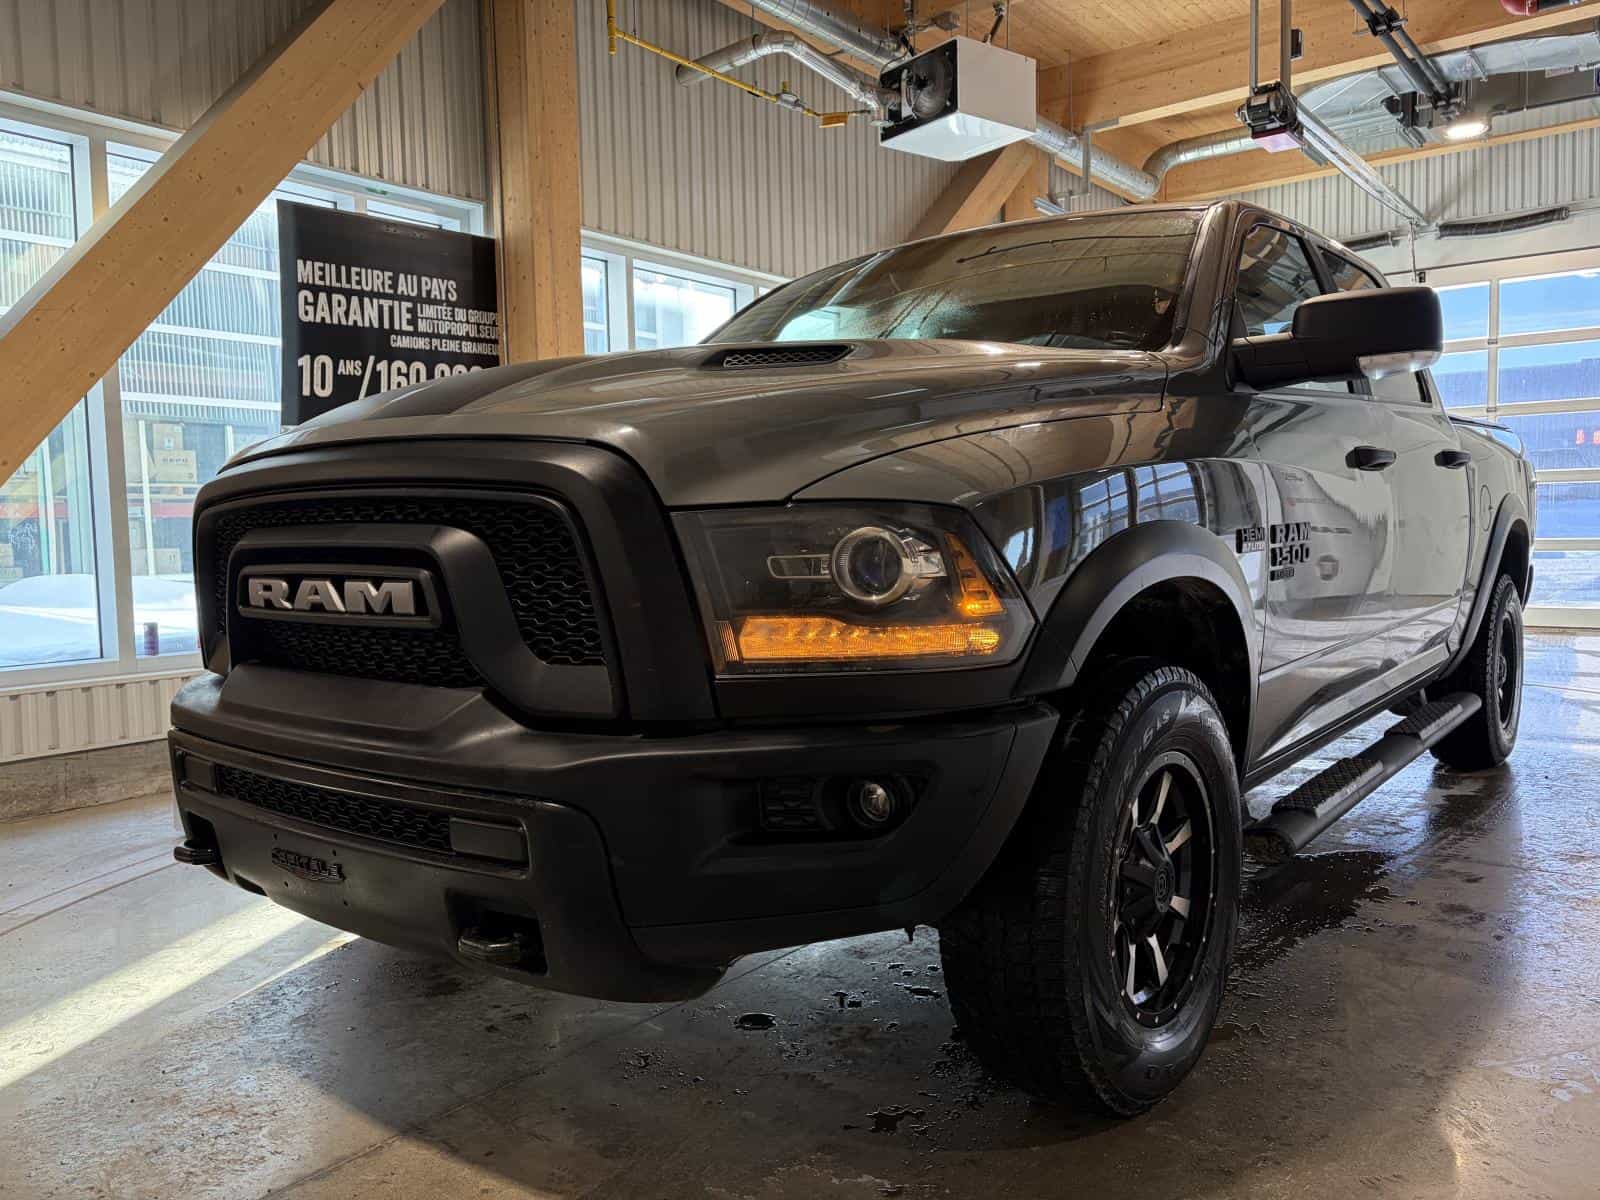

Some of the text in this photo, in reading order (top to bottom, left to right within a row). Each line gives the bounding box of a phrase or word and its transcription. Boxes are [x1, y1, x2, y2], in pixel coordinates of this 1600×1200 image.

[297, 259, 458, 301] MEILLEURE AU PAYS
[298, 290, 414, 331] GARANTIE
[417, 303, 453, 322] LIMITÉE
[455, 308, 467, 322] DU
[417, 319, 498, 339] MOTOPROPULSEU
[390, 334, 498, 356] CAMIONS PLEINE GRANDEU
[297, 354, 334, 398] 10
[337, 359, 362, 376] ANS
[1276, 522, 1311, 543] RAM
[249, 577, 415, 615] RAM
